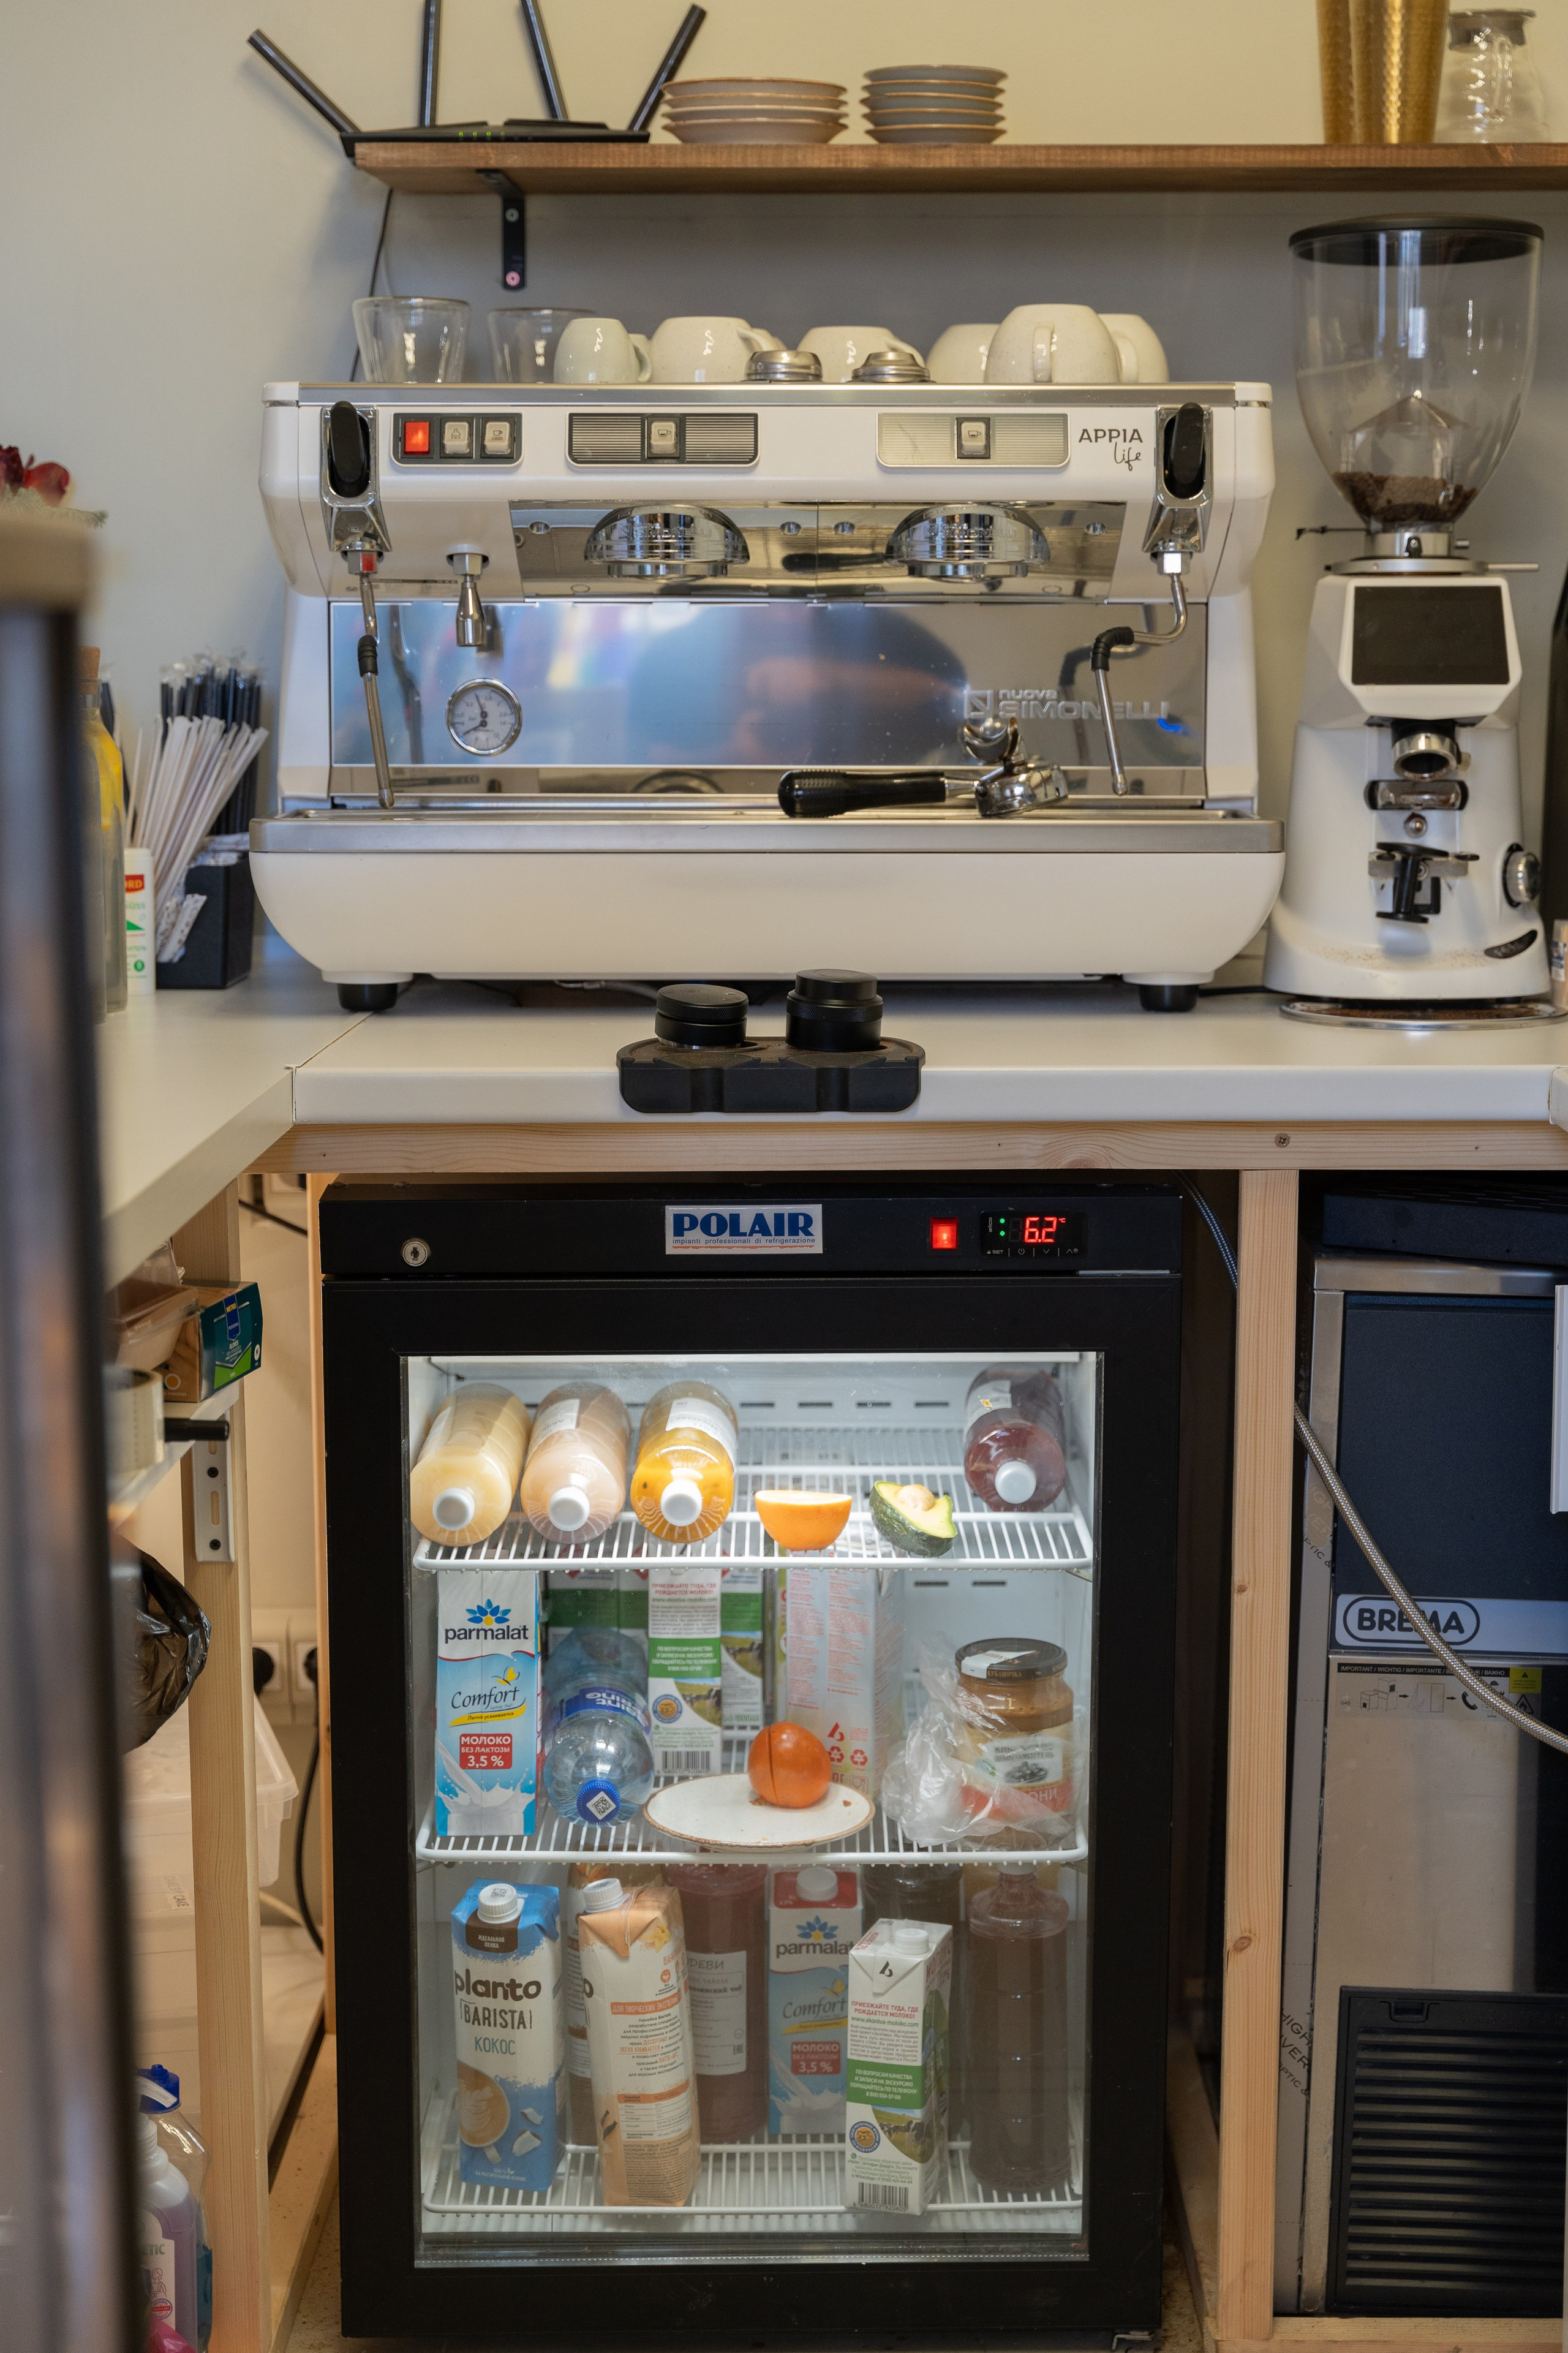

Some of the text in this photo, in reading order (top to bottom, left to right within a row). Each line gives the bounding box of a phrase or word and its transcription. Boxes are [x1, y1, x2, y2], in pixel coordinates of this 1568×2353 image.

[1079, 429, 1143, 442] APPIA
[1114, 442, 1141, 471] life
[998, 689, 1058, 700] nuova
[998, 700, 1169, 719] SIMONELLI
[673, 1212, 815, 1237] POLAIR
[1024, 1217, 1057, 1243] 6.2
[445, 1625, 529, 1644] parmalat
[451, 1686, 520, 1710] Comfort
[461, 1736, 511, 1745] МОЛОКО
[467, 1755, 504, 1769] 3,5 %
[454, 1968, 542, 2001] planto
[783, 1997, 847, 2019] Comfort
[851, 2001, 890, 2010] ПРИЕЗЖАЙТЕ
[854, 2008, 889, 2017] РОЖДАЕТСЯ
[464, 2004, 527, 2030] BARISTA
[851, 2017, 919, 2027] www.ekoniva-moloko.com
[474, 2036, 516, 2055] КОКОС
[792, 2044, 839, 2052] МОЛОКО
[799, 2061, 834, 2074] 3,5 %
